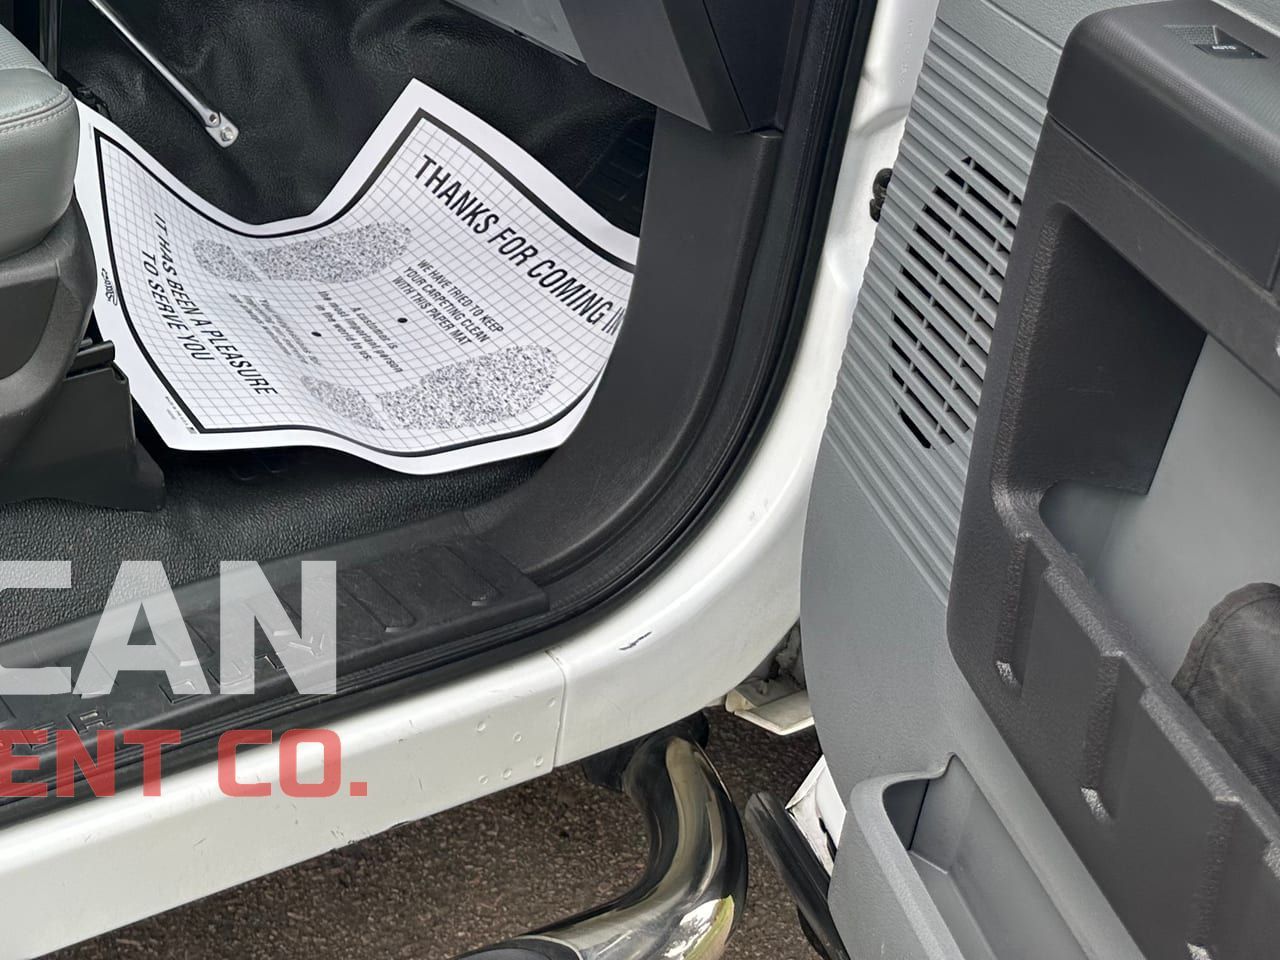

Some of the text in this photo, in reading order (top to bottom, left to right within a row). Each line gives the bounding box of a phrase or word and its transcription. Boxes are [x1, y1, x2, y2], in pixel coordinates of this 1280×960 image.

[141, 250, 159, 277] TO
[414, 154, 500, 234] THANKS
[487, 227, 539, 267] FOR
[527, 259, 614, 325] COMING
[148, 278, 190, 332] SERVE
[153, 212, 279, 395] IT HAS BEEN A PLEASURE
[355, 311, 392, 342] customer
[392, 275, 473, 346] WITH THIS PAPER MAT
[403, 266, 490, 343] YOUR CARPETING CLEAN
[417, 259, 505, 332] WE HAVE TRIED TO KEEP
[177, 334, 216, 361] YOU
